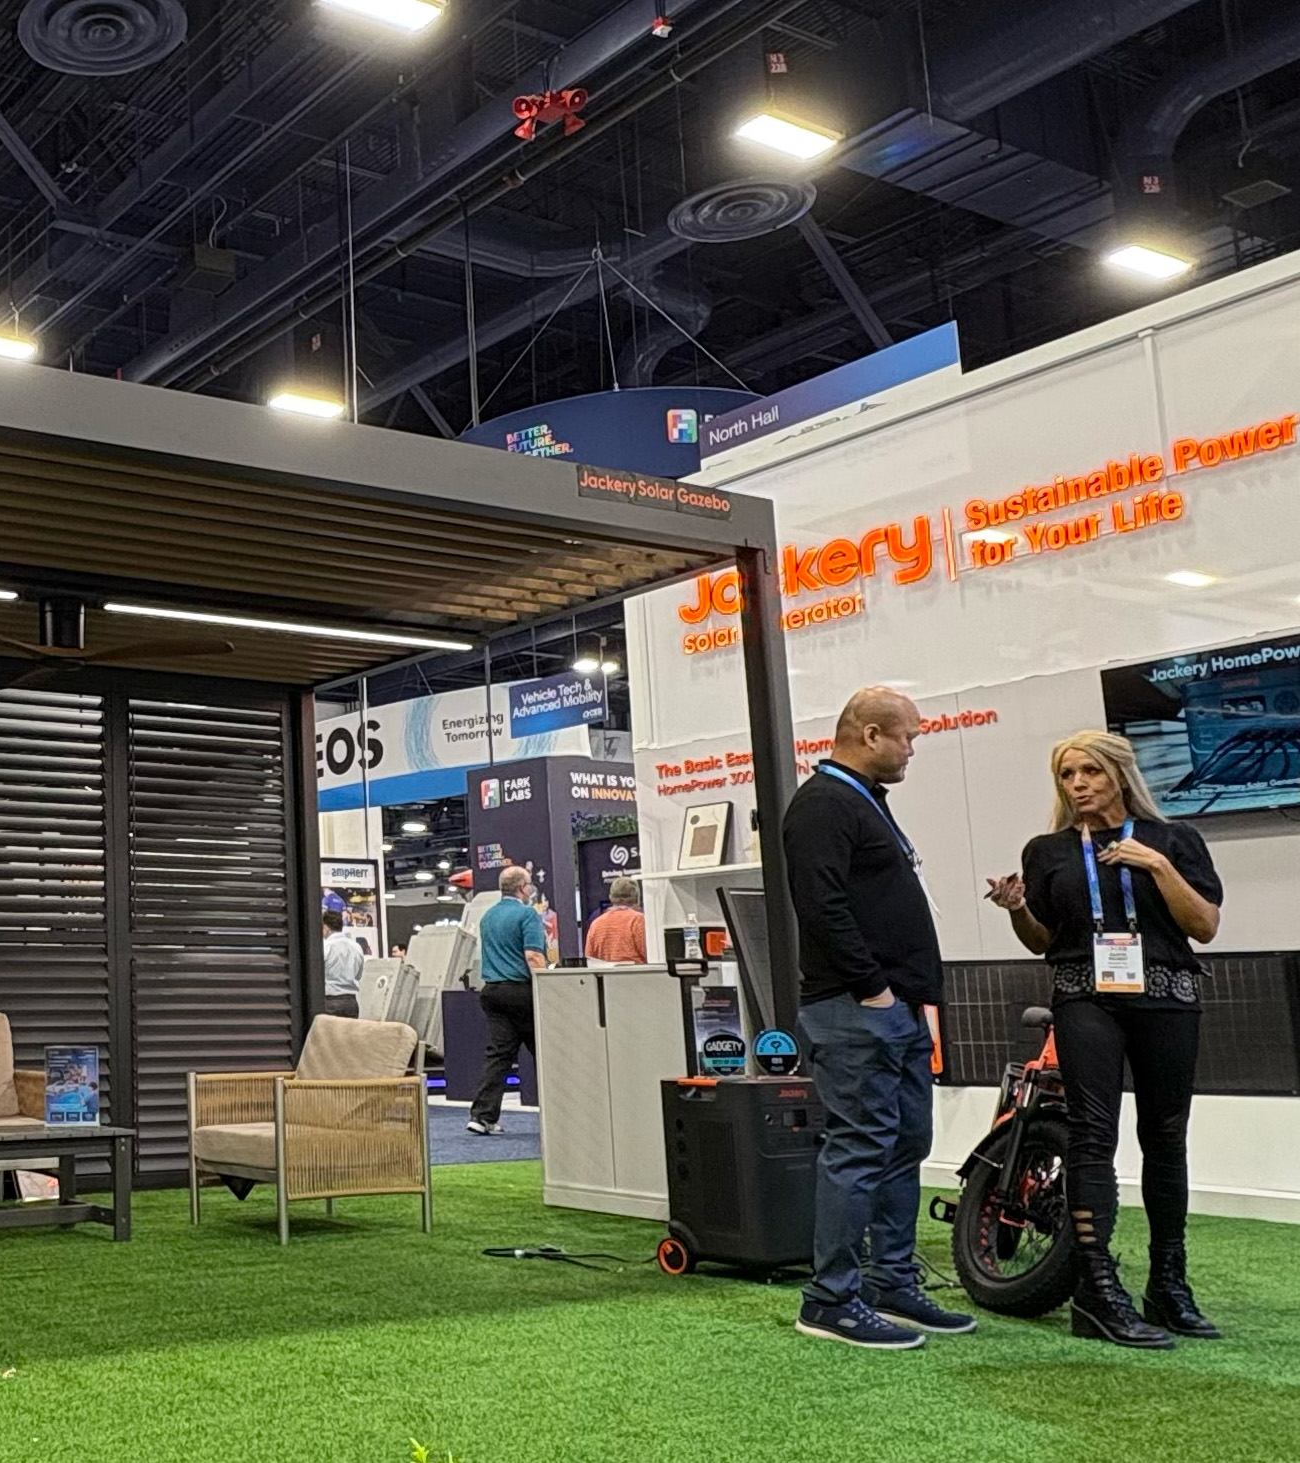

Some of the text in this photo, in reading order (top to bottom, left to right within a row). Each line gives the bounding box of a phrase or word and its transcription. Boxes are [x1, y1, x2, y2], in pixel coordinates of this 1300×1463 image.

[709, 405, 780, 446] North Hall
[964, 413, 1300, 531] Sustainable Power
[579, 471, 731, 512] Jackery Solar Gazebo
[971, 490, 1184, 569] for Your Life
[678, 514, 933, 624] Jakery
[1148, 660, 1209, 683] Jackery
[512, 689, 603, 719] Advanced Mobility
[521, 677, 592, 706] Vehicle Tech &
[442, 711, 504, 731] Energizing
[444, 726, 503, 744] Tomorrow
[655, 707, 998, 779] The Basic Ess Hom Solution
[504, 776, 530, 791] FARK
[570, 771, 636, 788] WHAT IS YO
[571, 786, 590, 799] ON
[657, 770, 754, 797] HomePower 300
[504, 788, 532, 803] LABS
